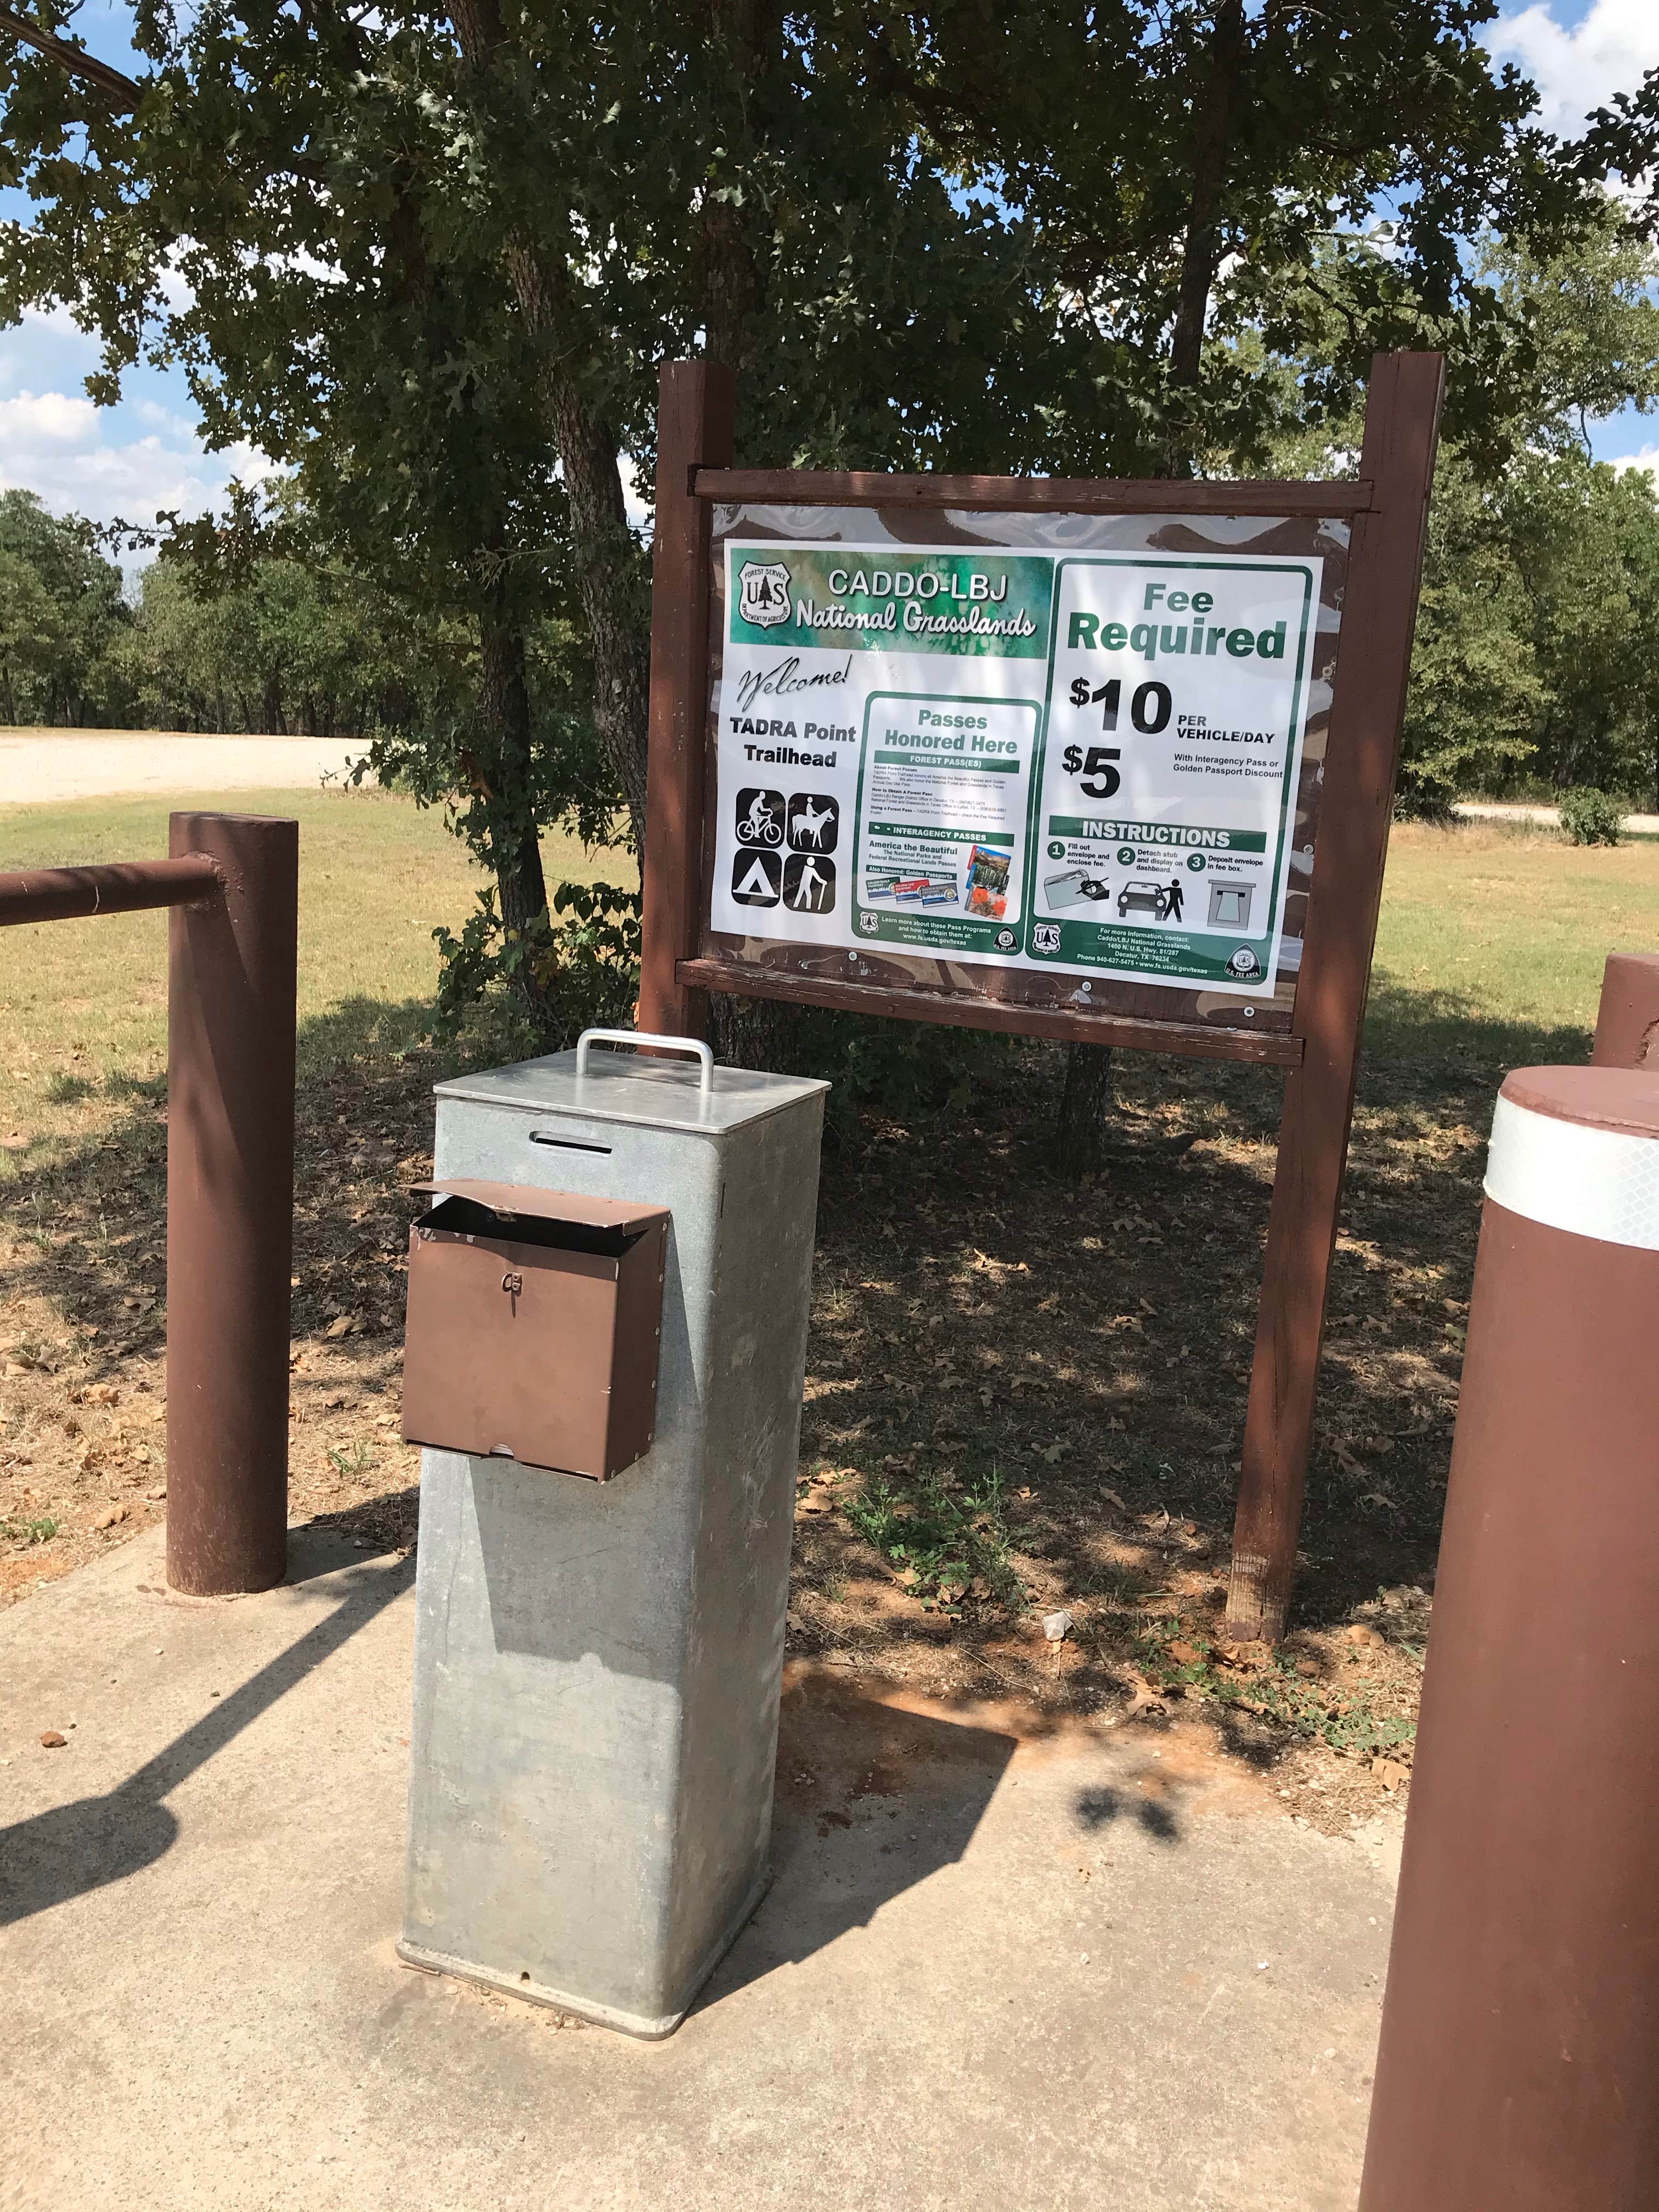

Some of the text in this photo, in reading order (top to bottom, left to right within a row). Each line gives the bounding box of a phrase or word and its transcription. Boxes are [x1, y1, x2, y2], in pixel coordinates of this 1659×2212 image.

[746, 569, 786, 581] FOREST SERVICE
[828, 569, 1006, 601] CADDO-LBJ
[1143, 583, 1214, 613] Fee
[742, 603, 761, 622] DEPARTMENT
[797, 599, 1036, 636] National Grasslands
[1068, 612, 1287, 661] Required
[737, 654, 853, 713] Welcome!
[1069, 677, 1172, 734] $10
[918, 709, 988, 729] Passes
[1178, 715, 1206, 726] PER
[730, 717, 856, 742] TADRA Point
[1177, 728, 1275, 743] VEHICLE/DAY
[884, 730, 1017, 754] Honored Here
[744, 744, 837, 768] Trailhead
[910, 755, 981, 769] FOREST PASS(ES)
[1174, 753, 1192, 761] With
[1195, 755, 1244, 766] Interagency
[1246, 758, 1267, 766] Pass
[1062, 744, 1121, 799] $5
[1173, 764, 1283, 778] Golden Passport Discount
[893, 827, 986, 841] INTERAGENCY PASSES
[1082, 821, 1230, 848] INSTRUCTIONS
[870, 840, 901, 849] America
[920, 845, 957, 855] Beautiful
[1052, 844, 1060, 855] 1
[1122, 850, 1131, 861] 2
[1192, 856, 1201, 868] 3
[903, 934, 966, 945] www.fs.usda.gov/texas
[1097, 935, 1130, 943] Caddo/LBJ
[1156, 941, 1190, 950] Grasslands
[1115, 951, 1139, 959] Decatur,
[1097, 956, 1134, 966] 940-627-5475
[1139, 962, 1207, 974] www.fs.usda.gov/texas
